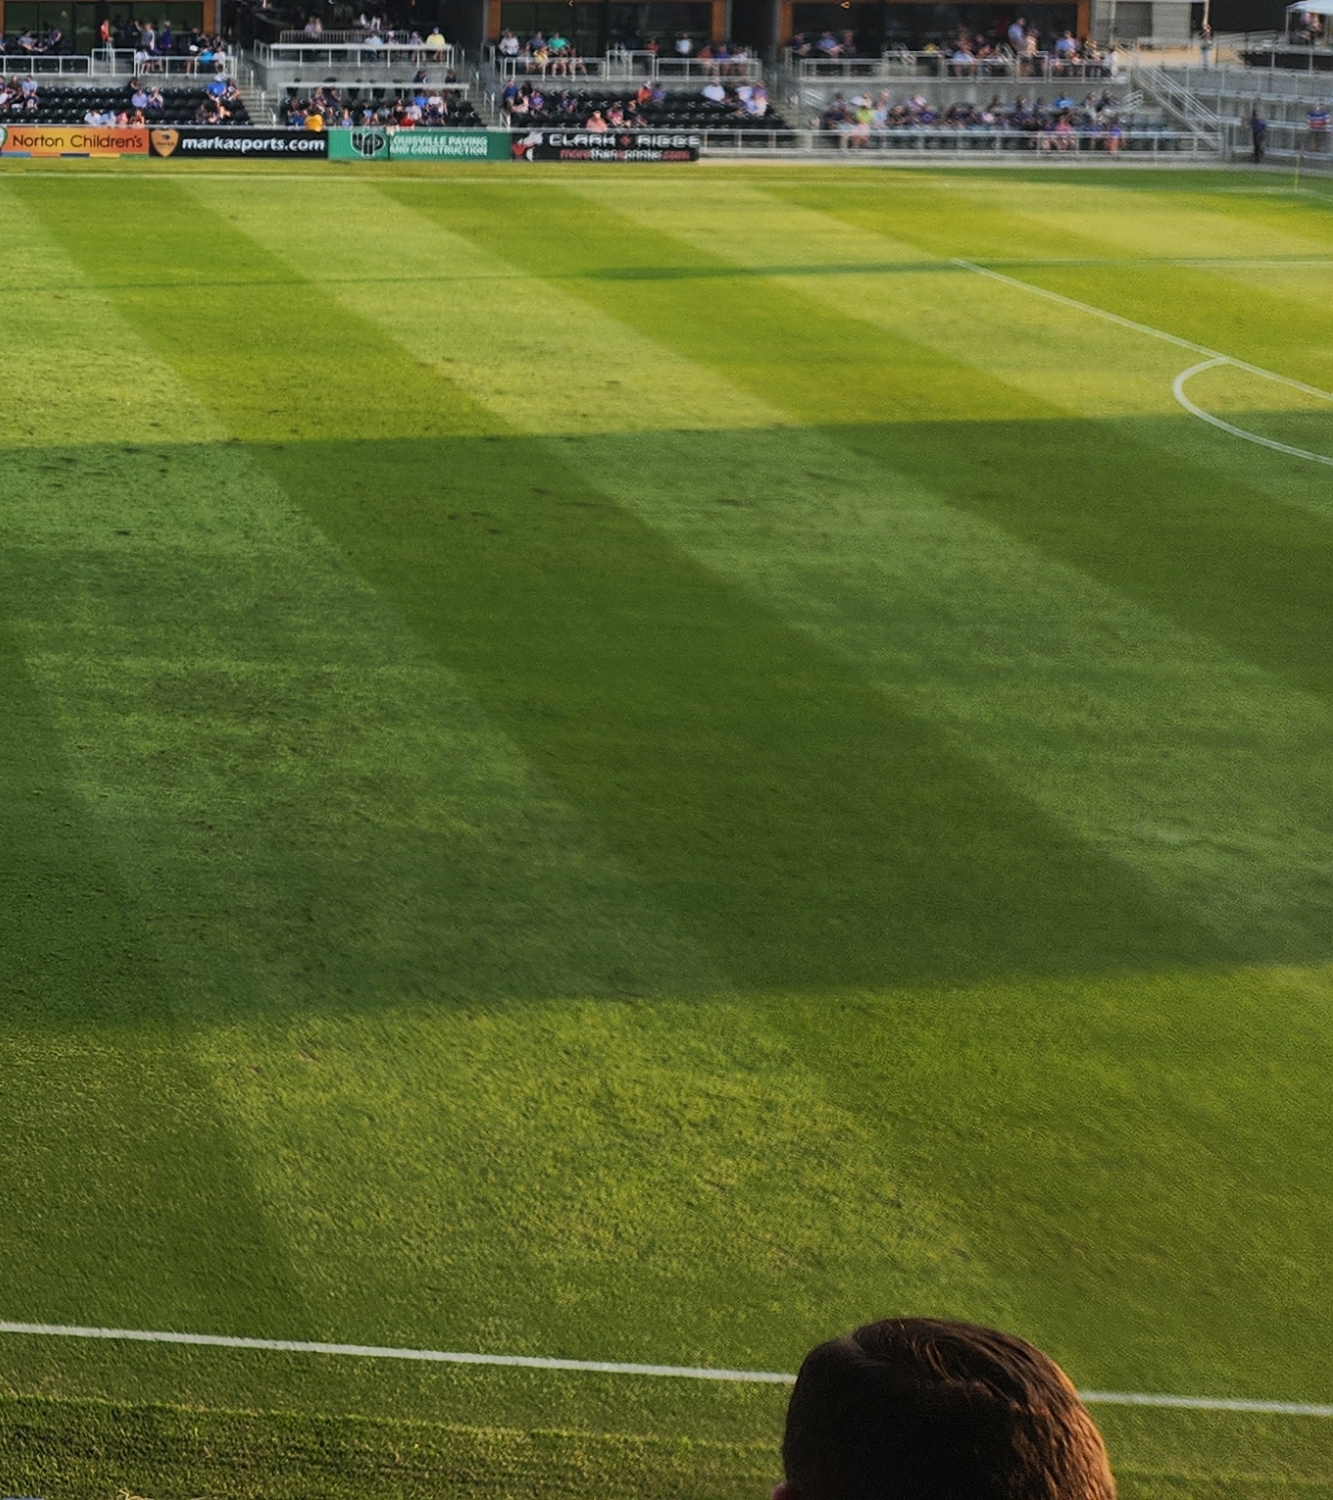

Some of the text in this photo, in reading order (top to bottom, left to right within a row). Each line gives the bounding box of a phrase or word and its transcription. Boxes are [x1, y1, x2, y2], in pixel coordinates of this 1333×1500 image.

[13, 134, 64, 148] Norton
[70, 134, 143, 149] Children's
[182, 136, 325, 153] markasports.com
[410, 145, 488, 157] CONSTRUCTION
